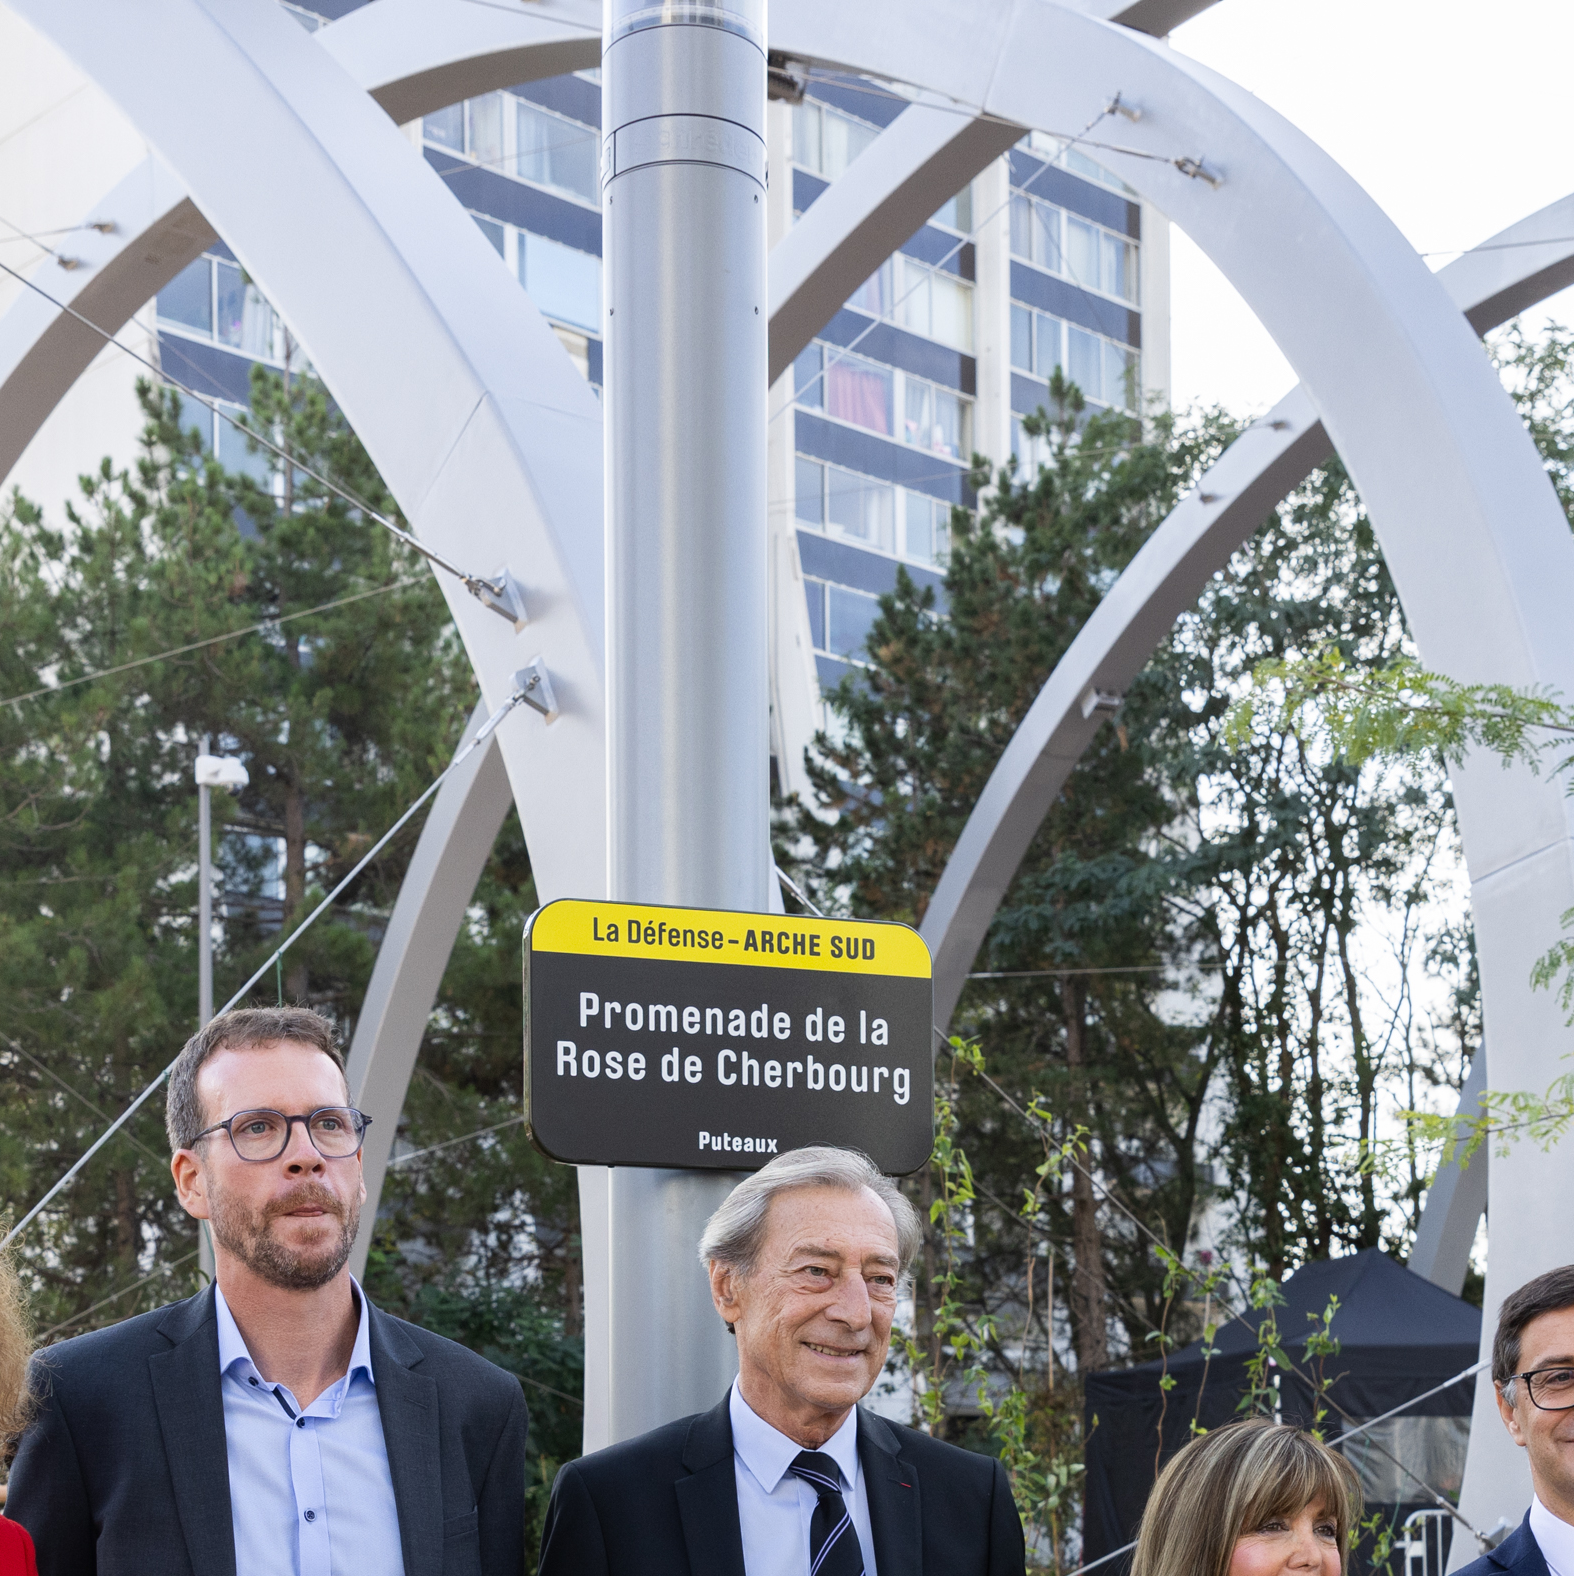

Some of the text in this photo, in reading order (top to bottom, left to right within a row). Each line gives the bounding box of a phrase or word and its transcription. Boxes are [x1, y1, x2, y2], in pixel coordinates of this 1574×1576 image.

[593, 917, 619, 943] La
[830, 935, 875, 960] SUD
[579, 991, 889, 1046] Promenade de la
[556, 1040, 910, 1105] Rose de Cherbourg
[698, 1131, 778, 1153] Puteaux
